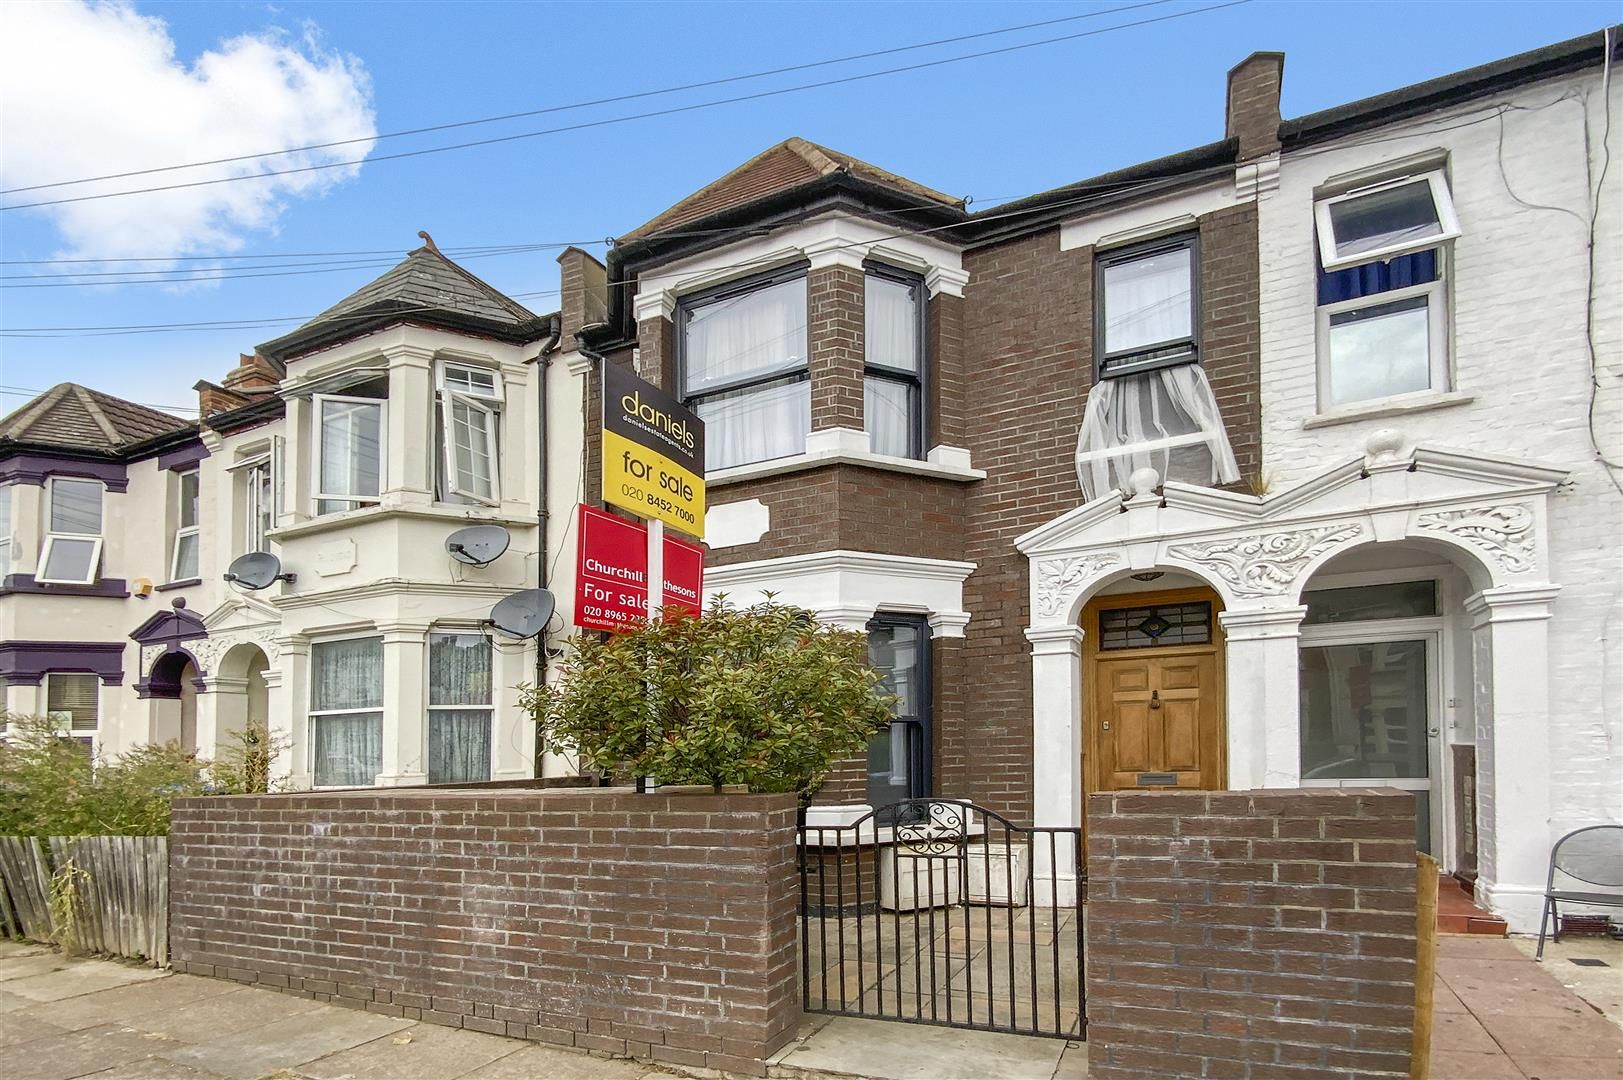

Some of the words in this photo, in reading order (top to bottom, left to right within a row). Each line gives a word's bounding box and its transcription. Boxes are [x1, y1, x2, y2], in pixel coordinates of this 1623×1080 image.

[621, 390, 695, 449] daniels
[622, 414, 694, 459] danielsestateagents.co.uk
[622, 451, 653, 481] for
[659, 470, 693, 502] sale
[621, 483, 644, 501] 020
[647, 493, 673, 513] 8452
[674, 505, 695, 524] 7000
[584, 582, 613, 602] For
[619, 593, 648, 610] sale
[585, 558, 643, 582] Churchill
[662, 580, 696, 599] thesons
[583, 605, 602, 617] 020
[604, 609, 627, 621] 8965
